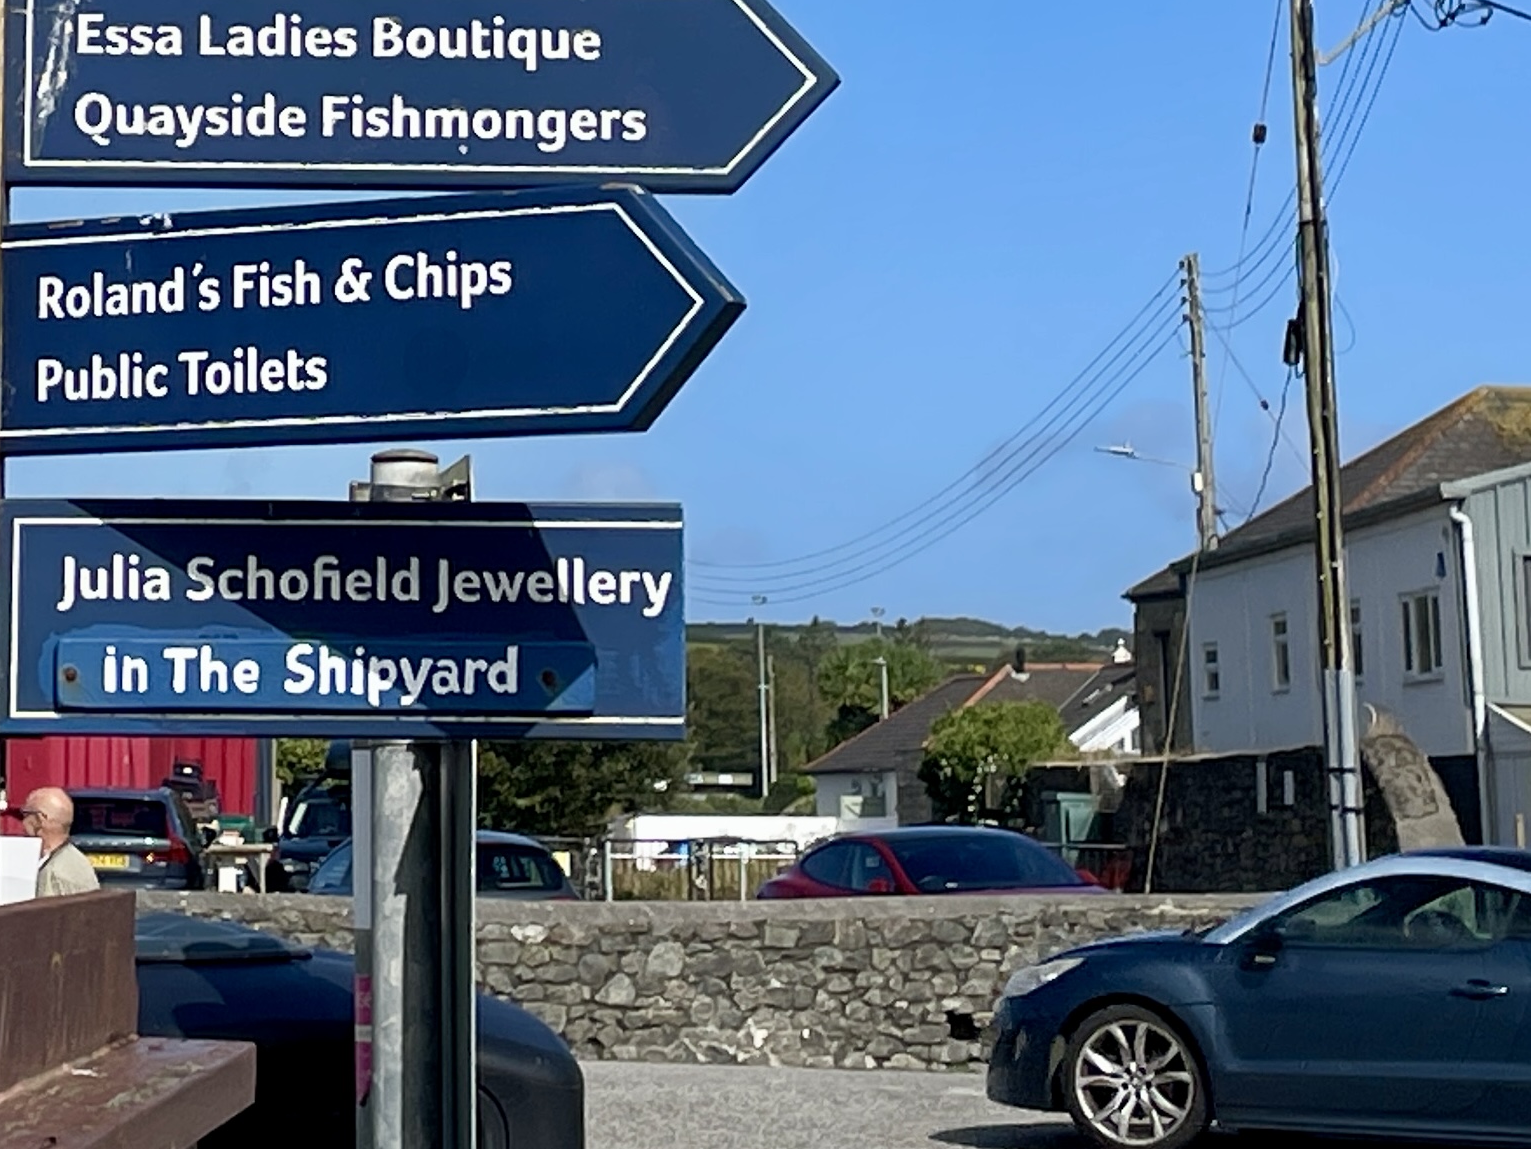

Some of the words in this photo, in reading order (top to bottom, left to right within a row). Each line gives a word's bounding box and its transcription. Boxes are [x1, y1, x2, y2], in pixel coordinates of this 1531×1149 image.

[76, 13, 183, 56] Essa
[199, 13, 358, 58] Ladies
[372, 15, 601, 72] Boutique
[74, 92, 307, 147] Quayside
[322, 93, 647, 153] Fishmongers
[233, 259, 321, 309] Fish
[334, 257, 373, 303] &
[384, 250, 512, 310] Chips
[37, 354, 169, 402] Public
[177, 347, 328, 396] Toilets
[56, 554, 171, 612] Julia
[185, 554, 420, 602] Schofield
[432, 557, 673, 618] Jewellery
[103, 645, 148, 694] in
[163, 647, 260, 694] The
[283, 644, 518, 707] Shipyard
